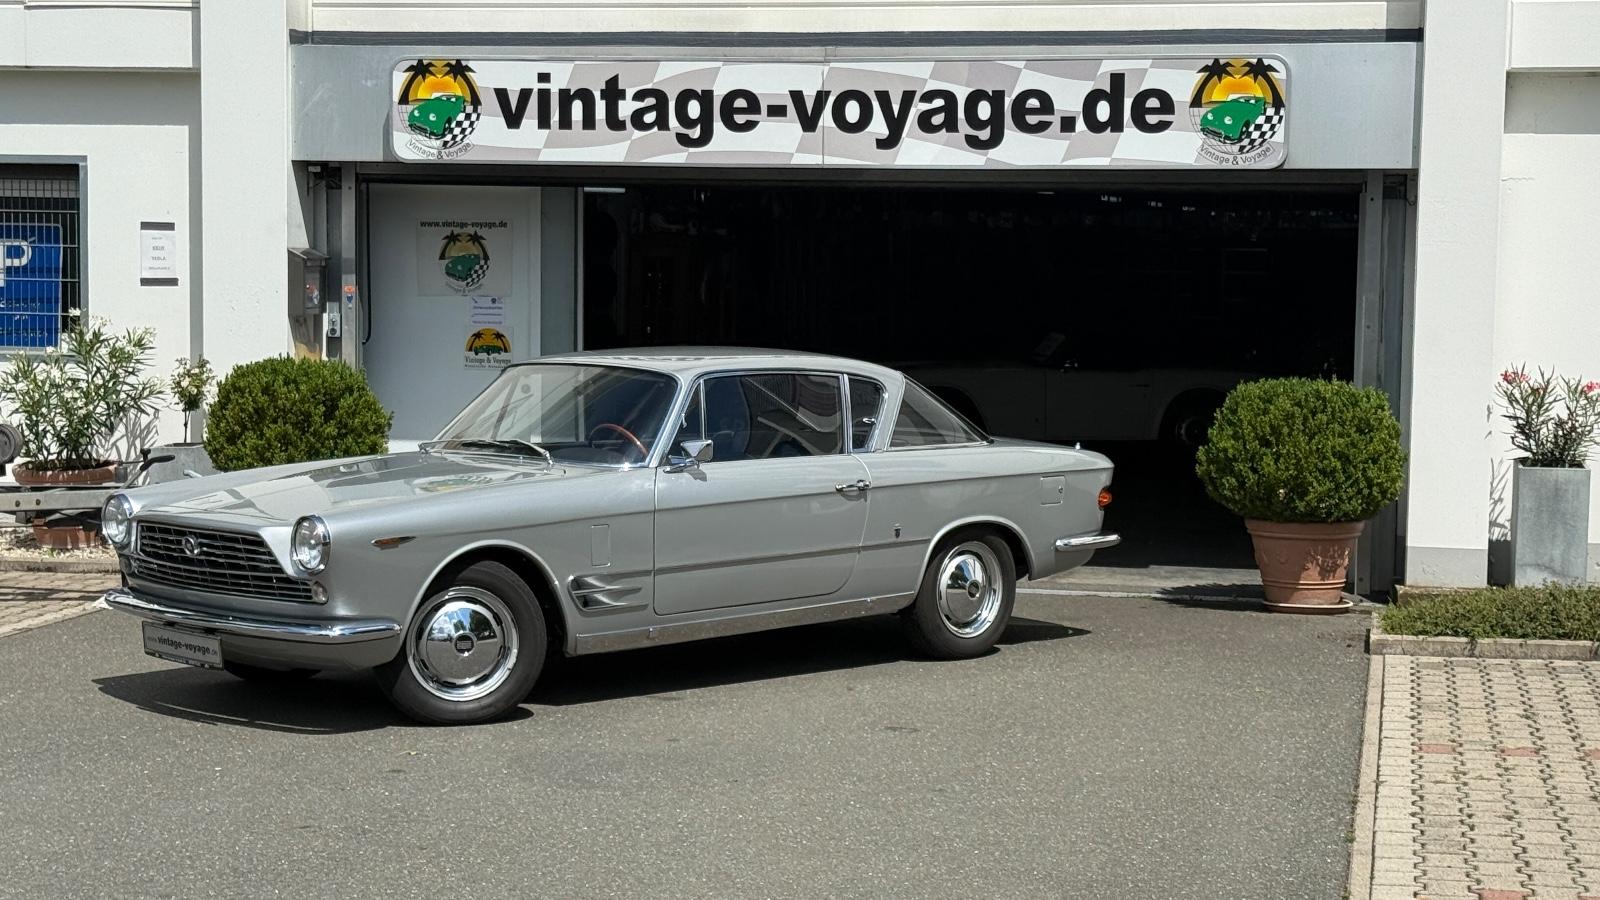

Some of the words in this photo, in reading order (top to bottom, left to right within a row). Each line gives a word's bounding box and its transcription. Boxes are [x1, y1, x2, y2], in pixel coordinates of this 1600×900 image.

[494, 72, 1176, 151] vintage-voyage.de
[408, 140, 436, 158] Vintage
[437, 152, 444, 160] &
[444, 142, 471, 159] Voyage
[1199, 144, 1230, 164] Vintage
[1231, 155, 1239, 166] &
[1240, 146, 1272, 164] Voyage
[420, 221, 508, 229] www.vintage-voyage.de
